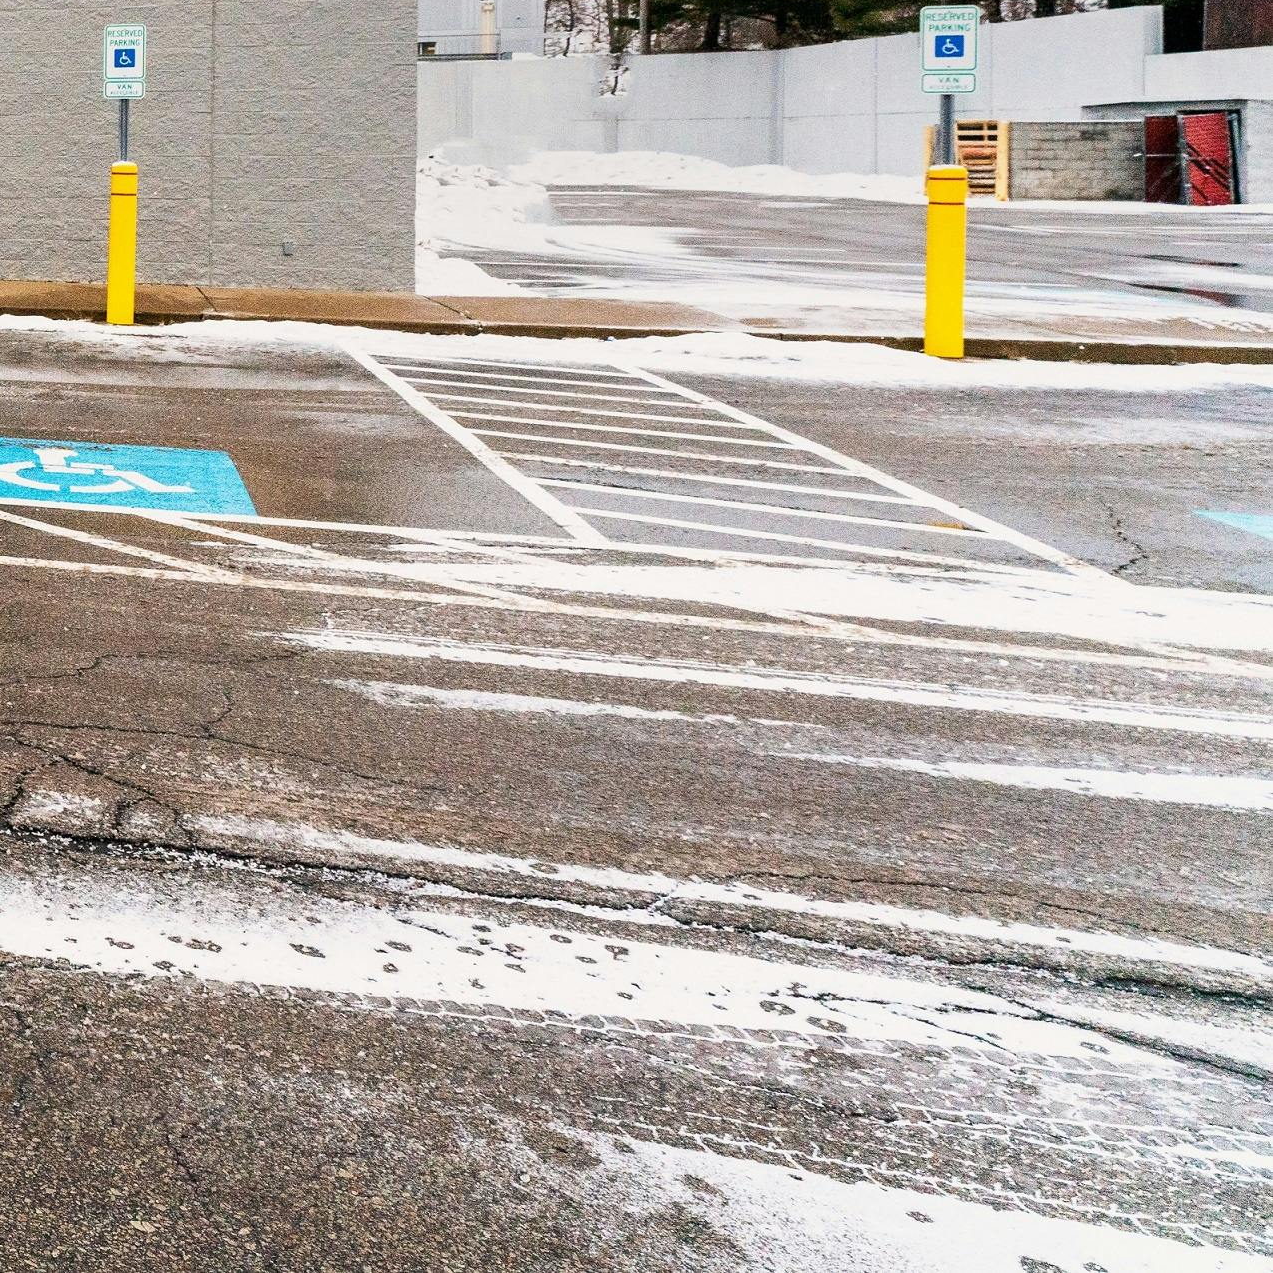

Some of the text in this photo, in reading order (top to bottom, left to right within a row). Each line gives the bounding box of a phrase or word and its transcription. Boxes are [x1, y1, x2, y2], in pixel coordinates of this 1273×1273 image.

[925, 12, 975, 21] RESERVED
[928, 24, 971, 32] PARKING
[107, 29, 143, 37] RESERVED
